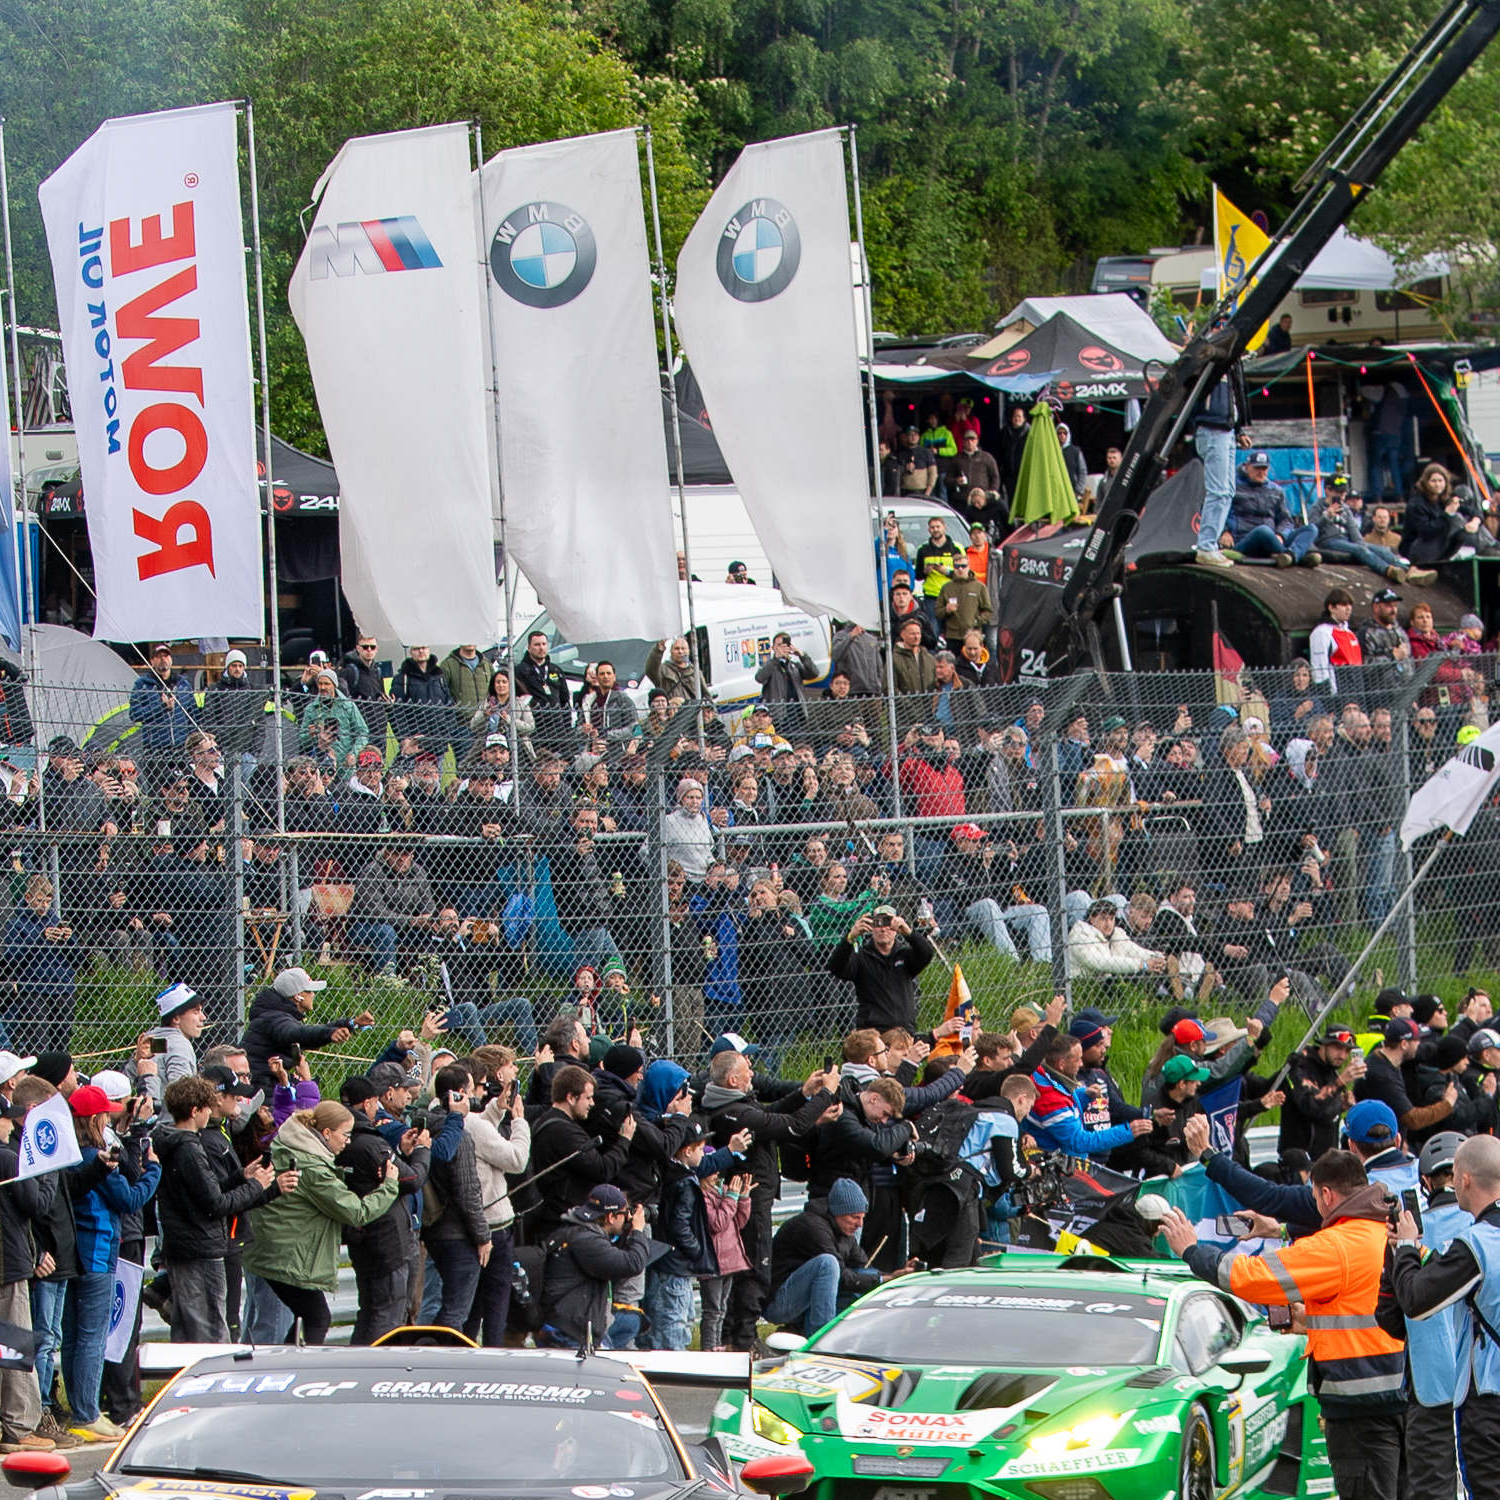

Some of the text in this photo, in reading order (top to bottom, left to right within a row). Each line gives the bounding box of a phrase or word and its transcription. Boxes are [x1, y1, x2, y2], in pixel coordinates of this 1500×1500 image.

[1076, 382, 1129, 398] 24MX
[370, 1381, 593, 1399] GRAN TURISMO
[869, 1410, 967, 1427] SONAX
[886, 1427, 972, 1441] Müller
[1008, 1451, 1132, 1476] SCHAEFFLER
